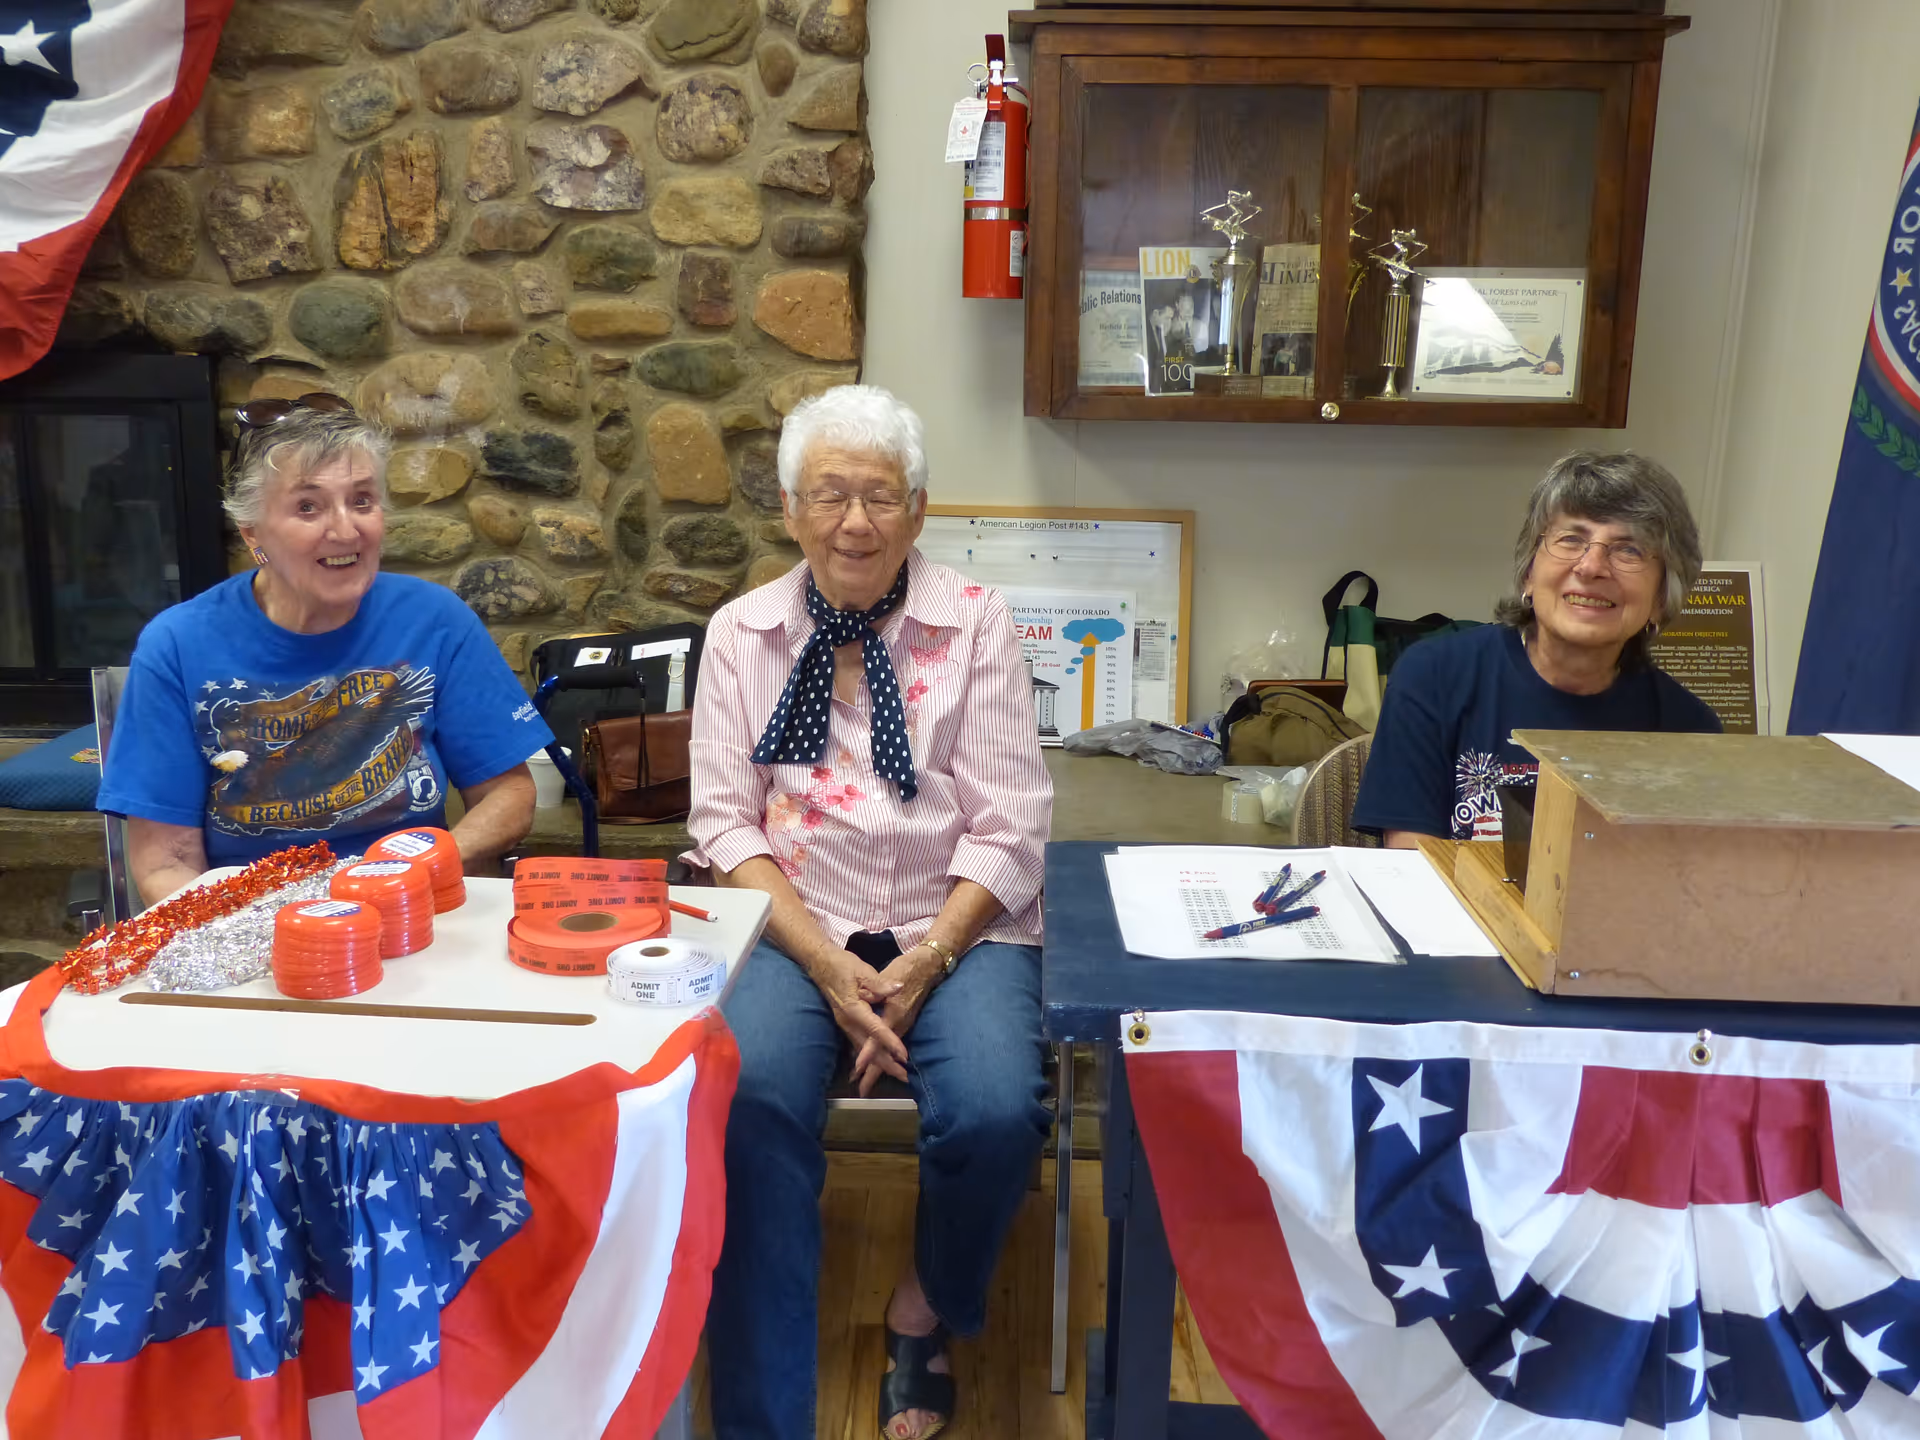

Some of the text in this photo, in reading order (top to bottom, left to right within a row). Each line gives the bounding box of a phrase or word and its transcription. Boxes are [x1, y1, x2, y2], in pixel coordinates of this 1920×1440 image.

[1142, 250, 1190, 277] LION
[1260, 262, 1319, 285] TIME
[1489, 288, 1519, 296] FOREST
[1521, 289, 1558, 297] PARTNER
[1080, 289, 1142, 314] blic Relations
[1161, 363, 1194, 382] 100
[979, 519, 1089, 531] American Legion Post #143
[1687, 594, 1746, 606] NAM WAR
[1012, 606, 1053, 615] PARTMENT
[1066, 608, 1110, 616] COLORADO
[1016, 625, 1053, 641] EAM
[254, 711, 310, 740] HOME
[338, 673, 385, 709] FREE
[249, 732, 410, 823] BECAUSE OF THE BRAVE
[540, 872, 561, 880] ADMIT
[570, 872, 610, 881] ADMIT ONE
[541, 900, 578, 910] ADMIT ONE
[588, 897, 626, 907] ADMIT ONE
[630, 981, 660, 991] ADMIT
[688, 973, 714, 988] ADMIT
[636, 991, 655, 999] ONE
[694, 983, 710, 995] ONE
